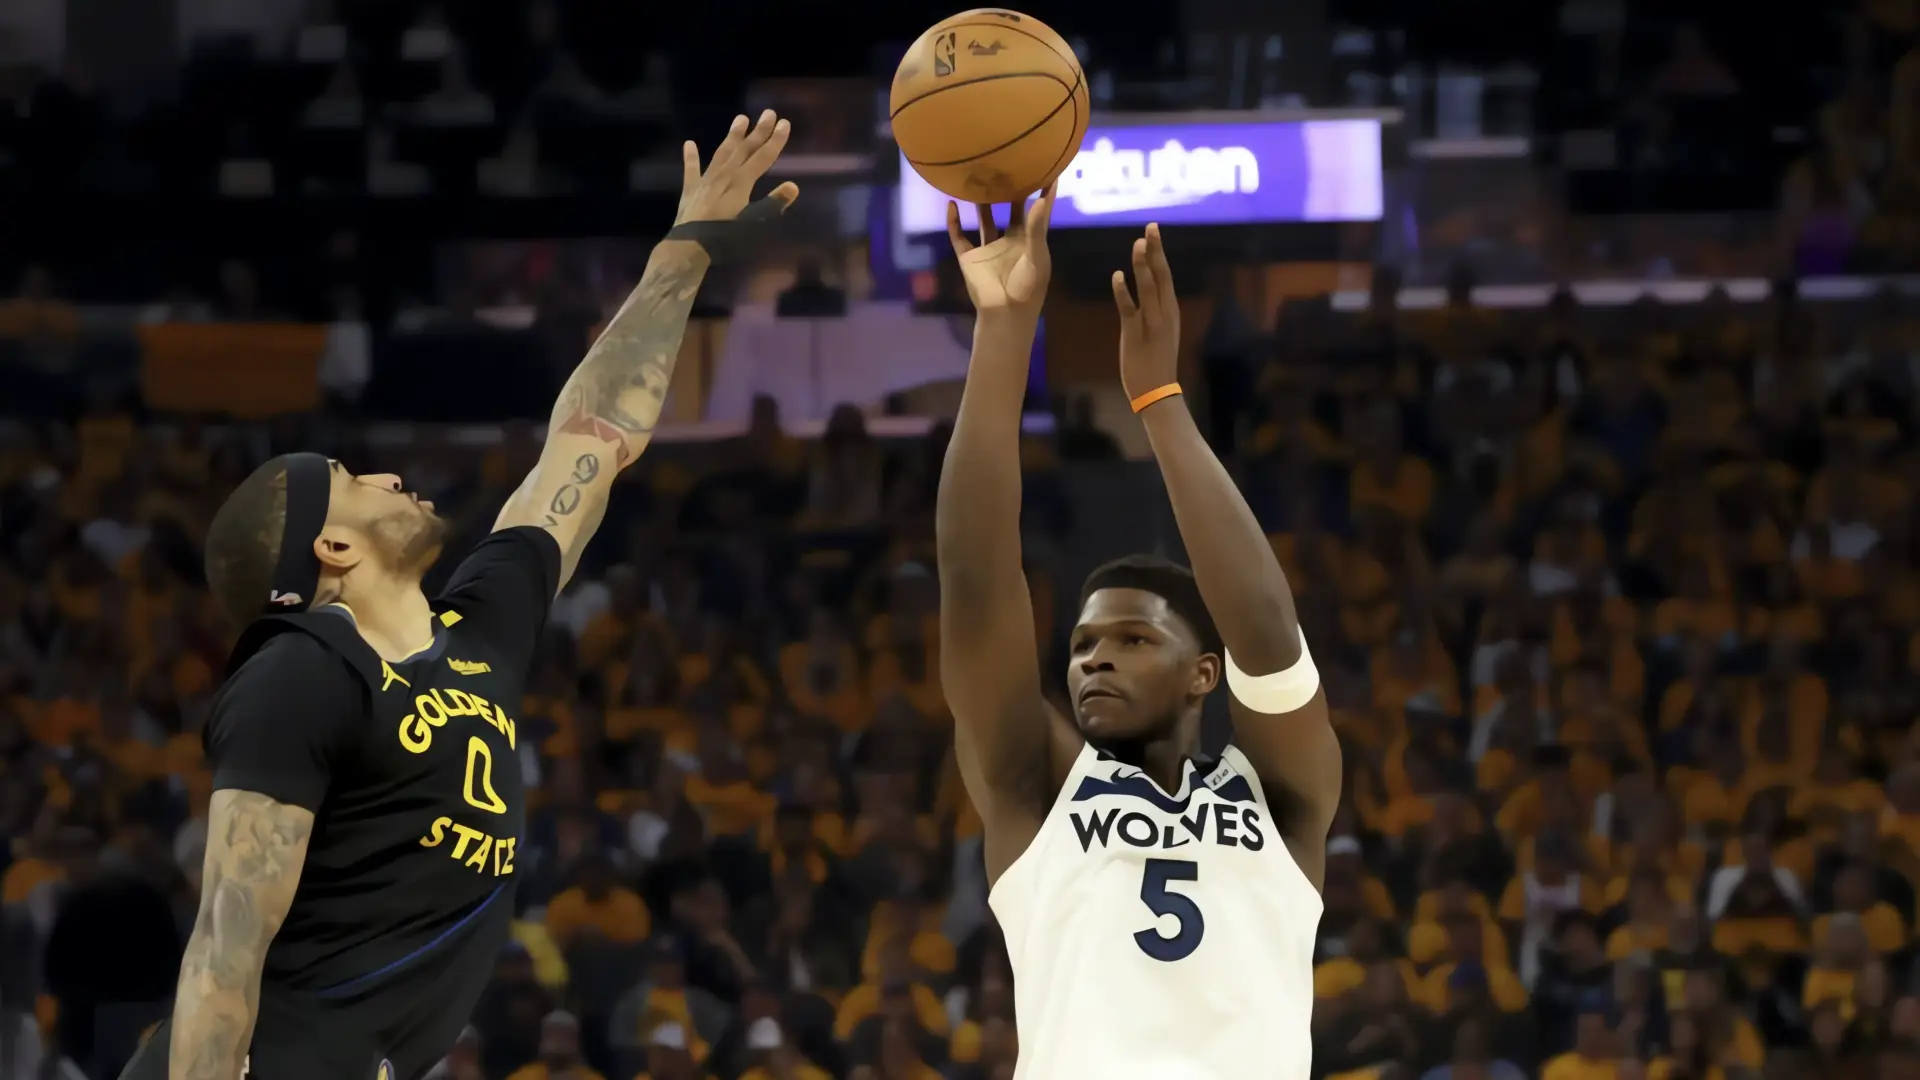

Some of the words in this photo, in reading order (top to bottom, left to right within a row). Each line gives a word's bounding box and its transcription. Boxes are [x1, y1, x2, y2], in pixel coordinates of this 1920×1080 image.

[1057, 136, 1260, 204] akuten
[398, 687, 516, 754] GOLDEN
[462, 735, 508, 815] 0
[419, 816, 516, 877] STATE
[1068, 802, 1265, 854] WOLVES
[1132, 857, 1205, 962] 5
